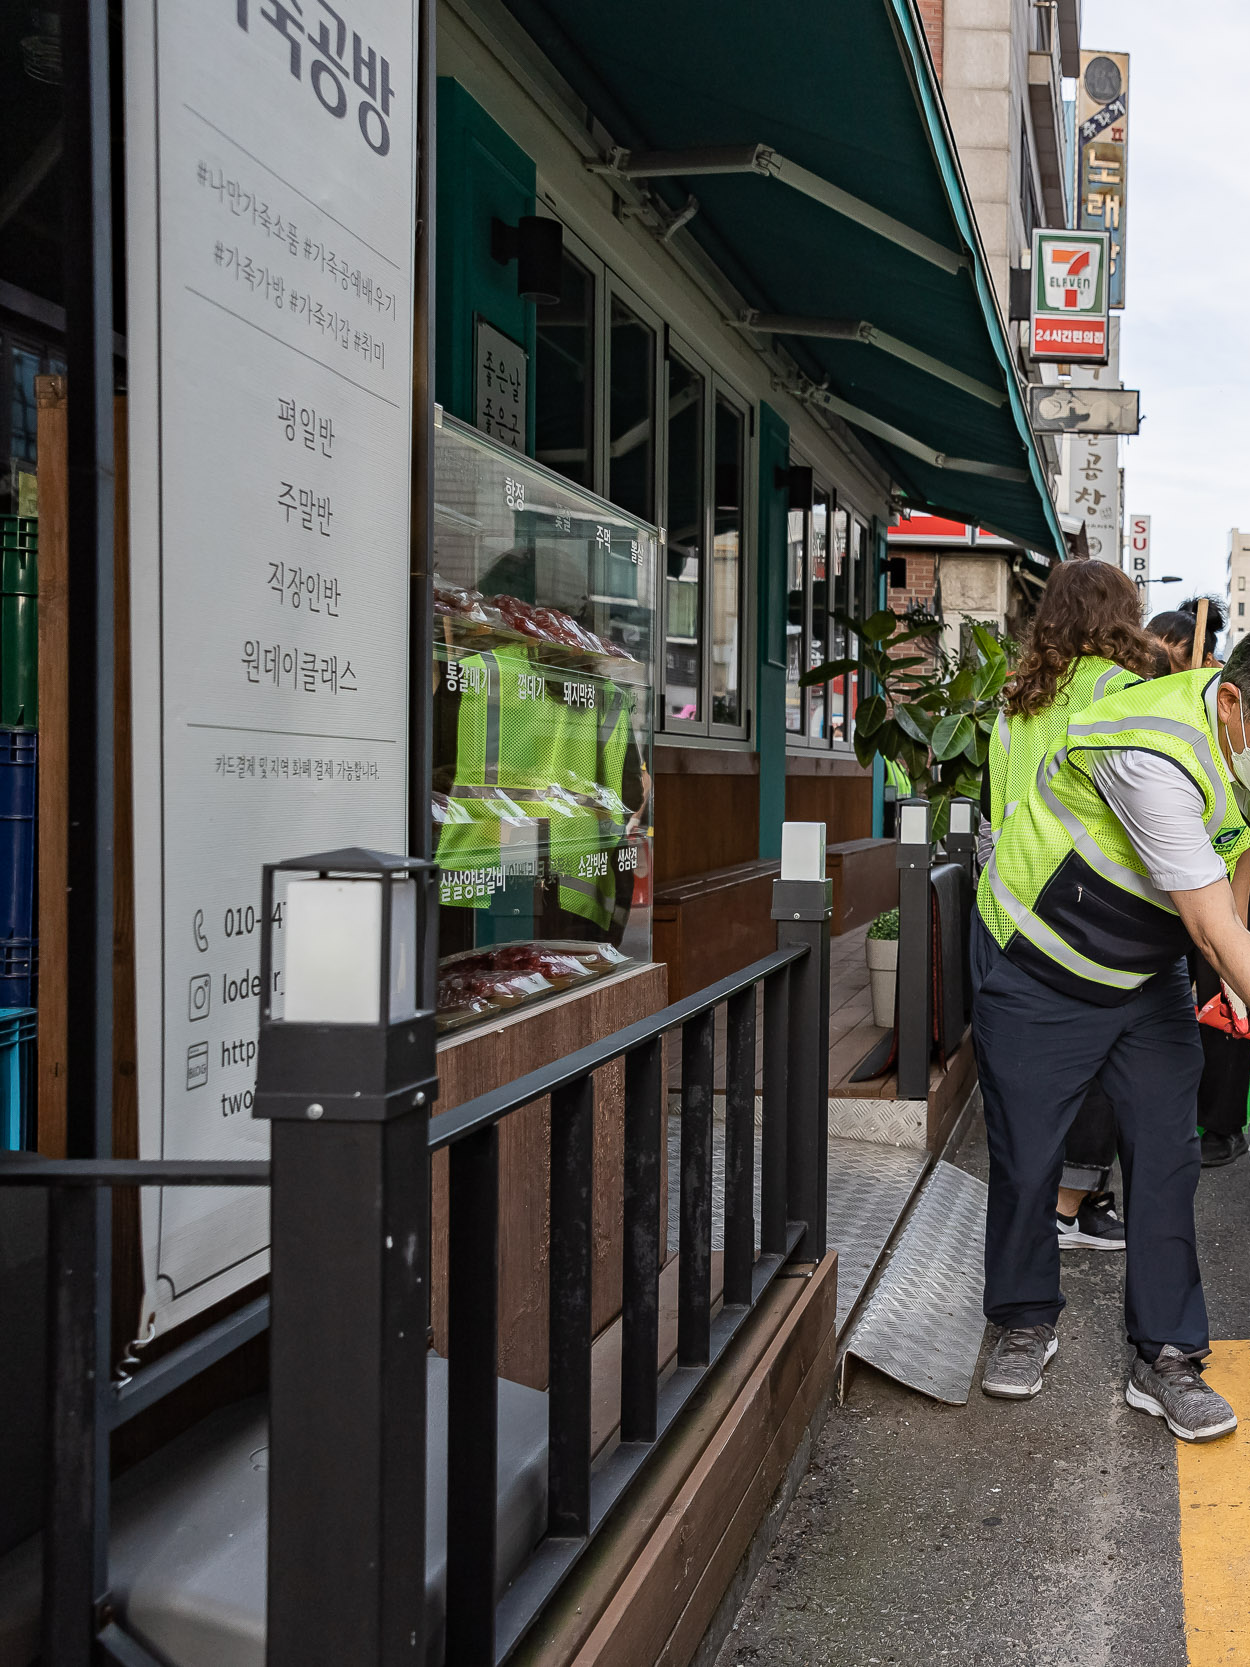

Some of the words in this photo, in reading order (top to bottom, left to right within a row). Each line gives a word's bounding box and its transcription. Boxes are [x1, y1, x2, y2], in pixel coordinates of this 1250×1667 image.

[237, 0, 394, 156] 죽공방
[197, 161, 299, 256] #나만가죽소품
[303, 237, 396, 321] #가죽공예배우기
[214, 240, 285, 309] #가죽가방
[290, 290, 350, 350] #가죽지갑
[353, 330, 385, 369] #취미
[1035, 328, 1105, 345] 24시간편의점
[277, 397, 336, 459] 평일반
[277, 480, 334, 538] 주말반
[505, 477, 525, 512] 항정
[596, 525, 611, 554] 주먹
[267, 561, 342, 618] 직장인반
[240, 639, 359, 695] 원데이클래스
[446, 660, 491, 696] 통갈매기
[518, 673, 545, 703] 껍데기
[563, 681, 596, 710] 돼지막창
[216, 754, 256, 779] 카드결제
[440, 864, 506, 903] 살살양념갈비
